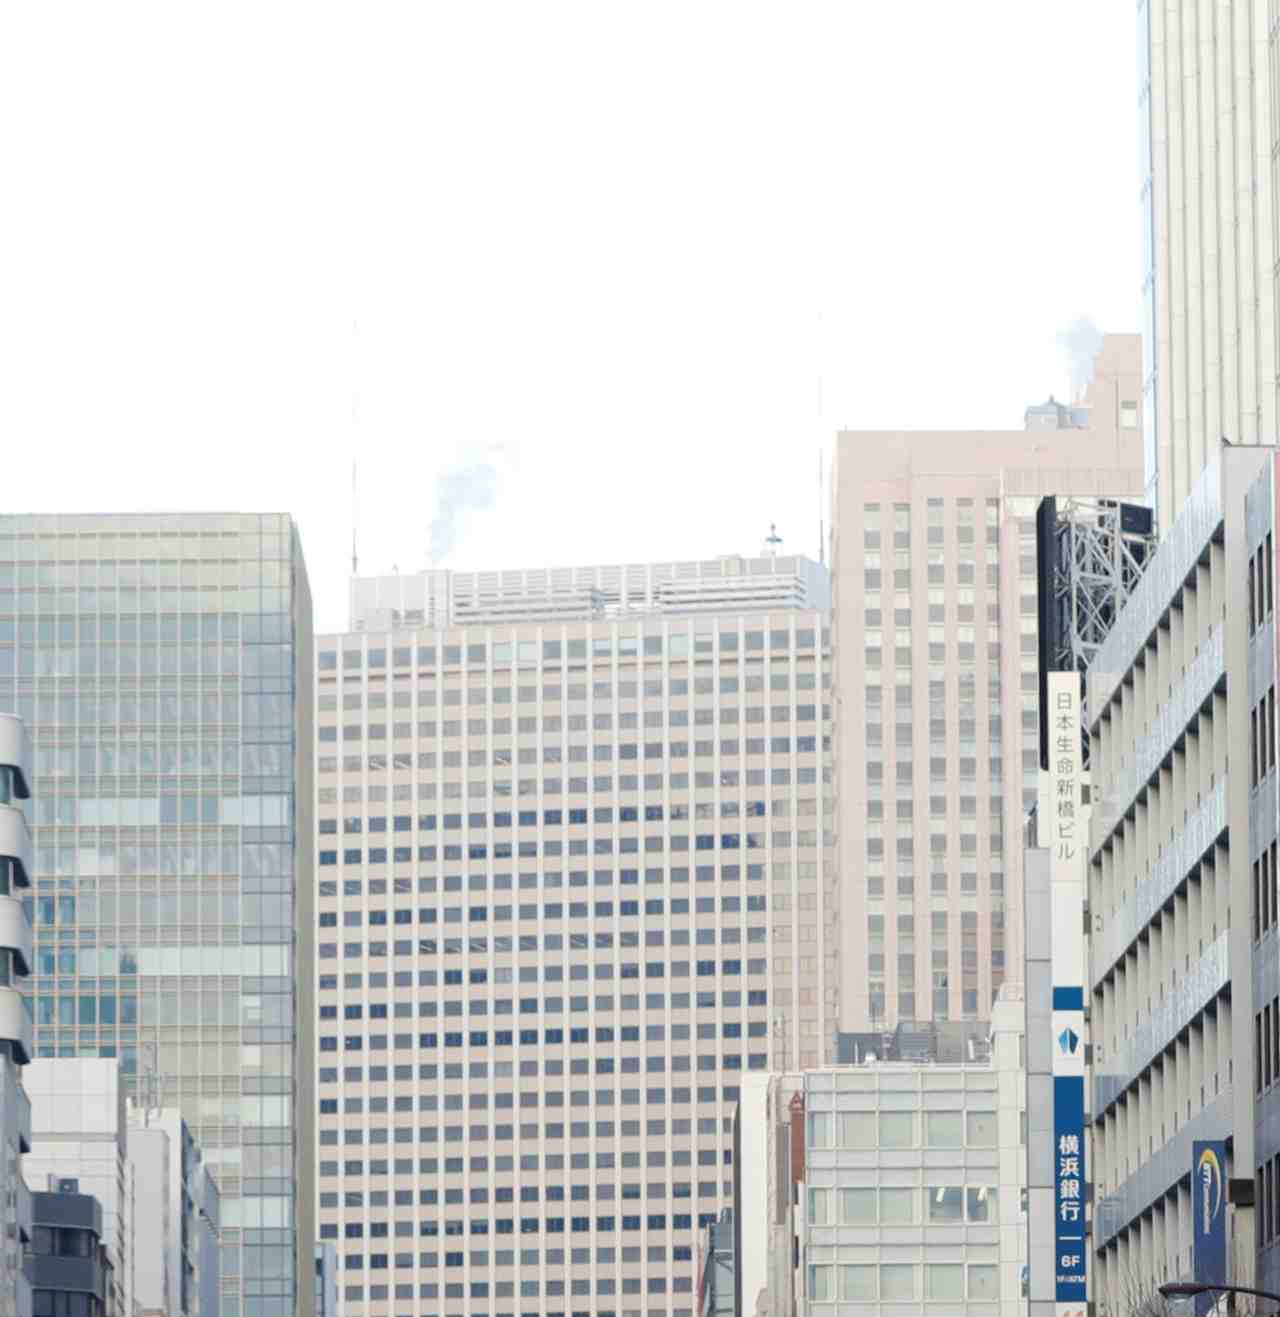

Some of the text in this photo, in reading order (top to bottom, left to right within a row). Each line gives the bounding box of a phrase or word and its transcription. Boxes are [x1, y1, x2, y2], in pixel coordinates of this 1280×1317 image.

[1056, 691, 1075, 861] 日本生命新橋ビル
[1058, 1134, 1081, 1222] 横浜銀行
